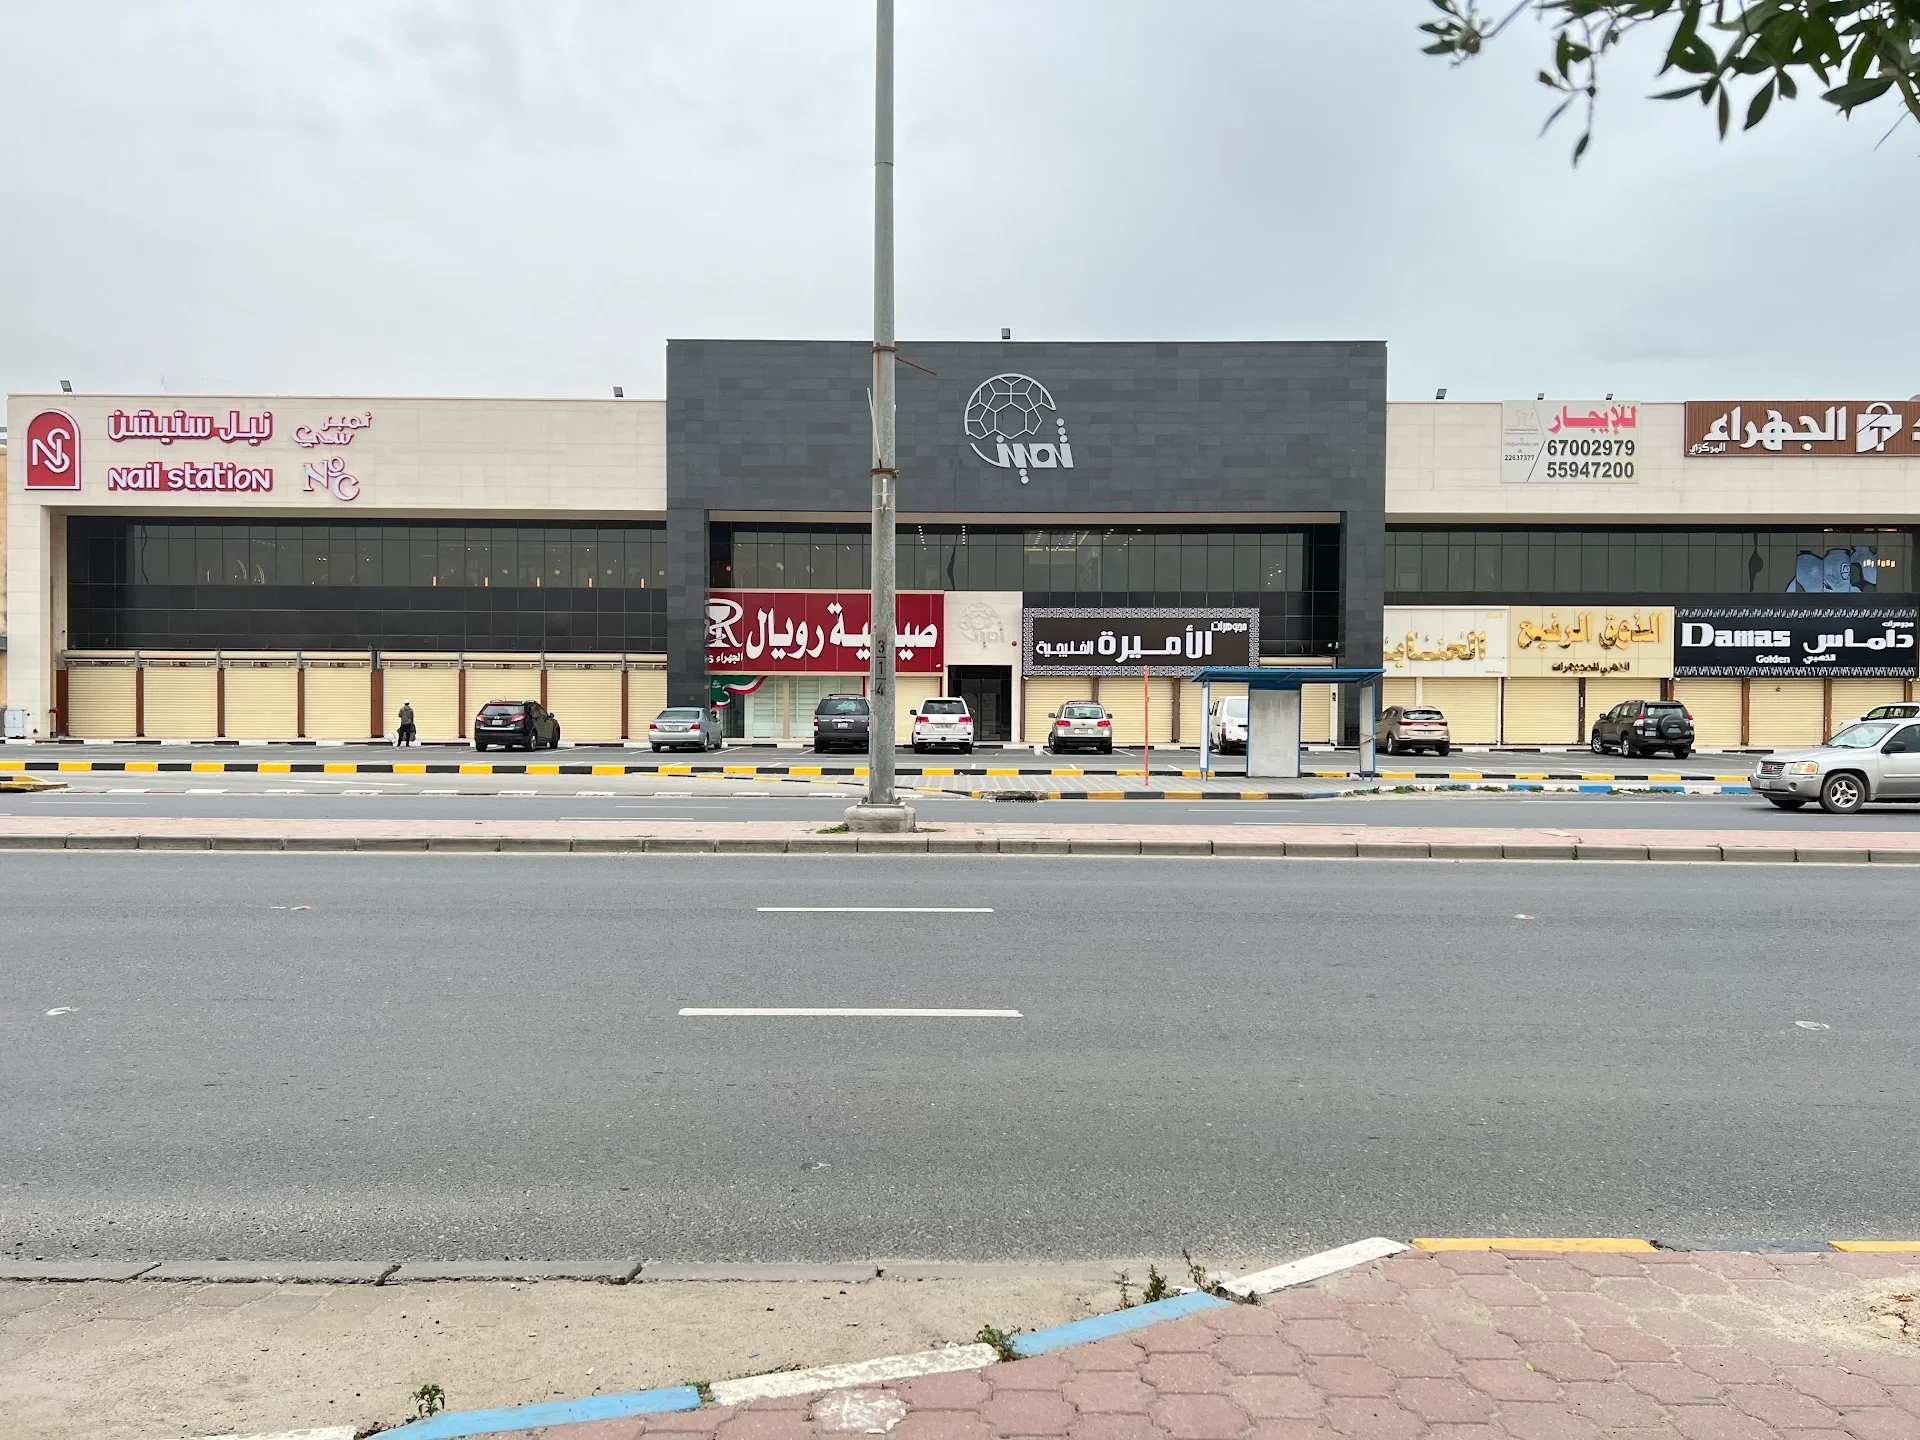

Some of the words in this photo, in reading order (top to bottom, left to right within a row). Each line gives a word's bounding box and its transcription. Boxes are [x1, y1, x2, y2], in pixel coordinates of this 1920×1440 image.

[108, 409, 213, 446] ستيشن
[219, 411, 273, 446] نيل
[1548, 404, 1637, 435] للإيجار
[1703, 405, 1847, 451] الجهراء
[292, 424, 354, 448] سي
[1547, 439, 1636, 457] 67002979
[1689, 442, 1726, 456] المركزي
[1546, 461, 1635, 479] 55947200
[746, 607, 826, 659] رويال
[827, 602, 938, 661] صيية
[1211, 620, 1248, 632] مجوهرات
[1518, 611, 1594, 649] الرفيع
[1599, 611, 1666, 650] الذوق
[1681, 622, 1791, 647] Damas
[1881, 620, 1915, 628] مجوهرات
[1035, 639, 1095, 658] الخليجية
[1098, 624, 1214, 664] الأميرة
[1802, 628, 1915, 653] داماس
[1755, 654, 1791, 664] Golden
[1802, 653, 1836, 664] الذهبي
